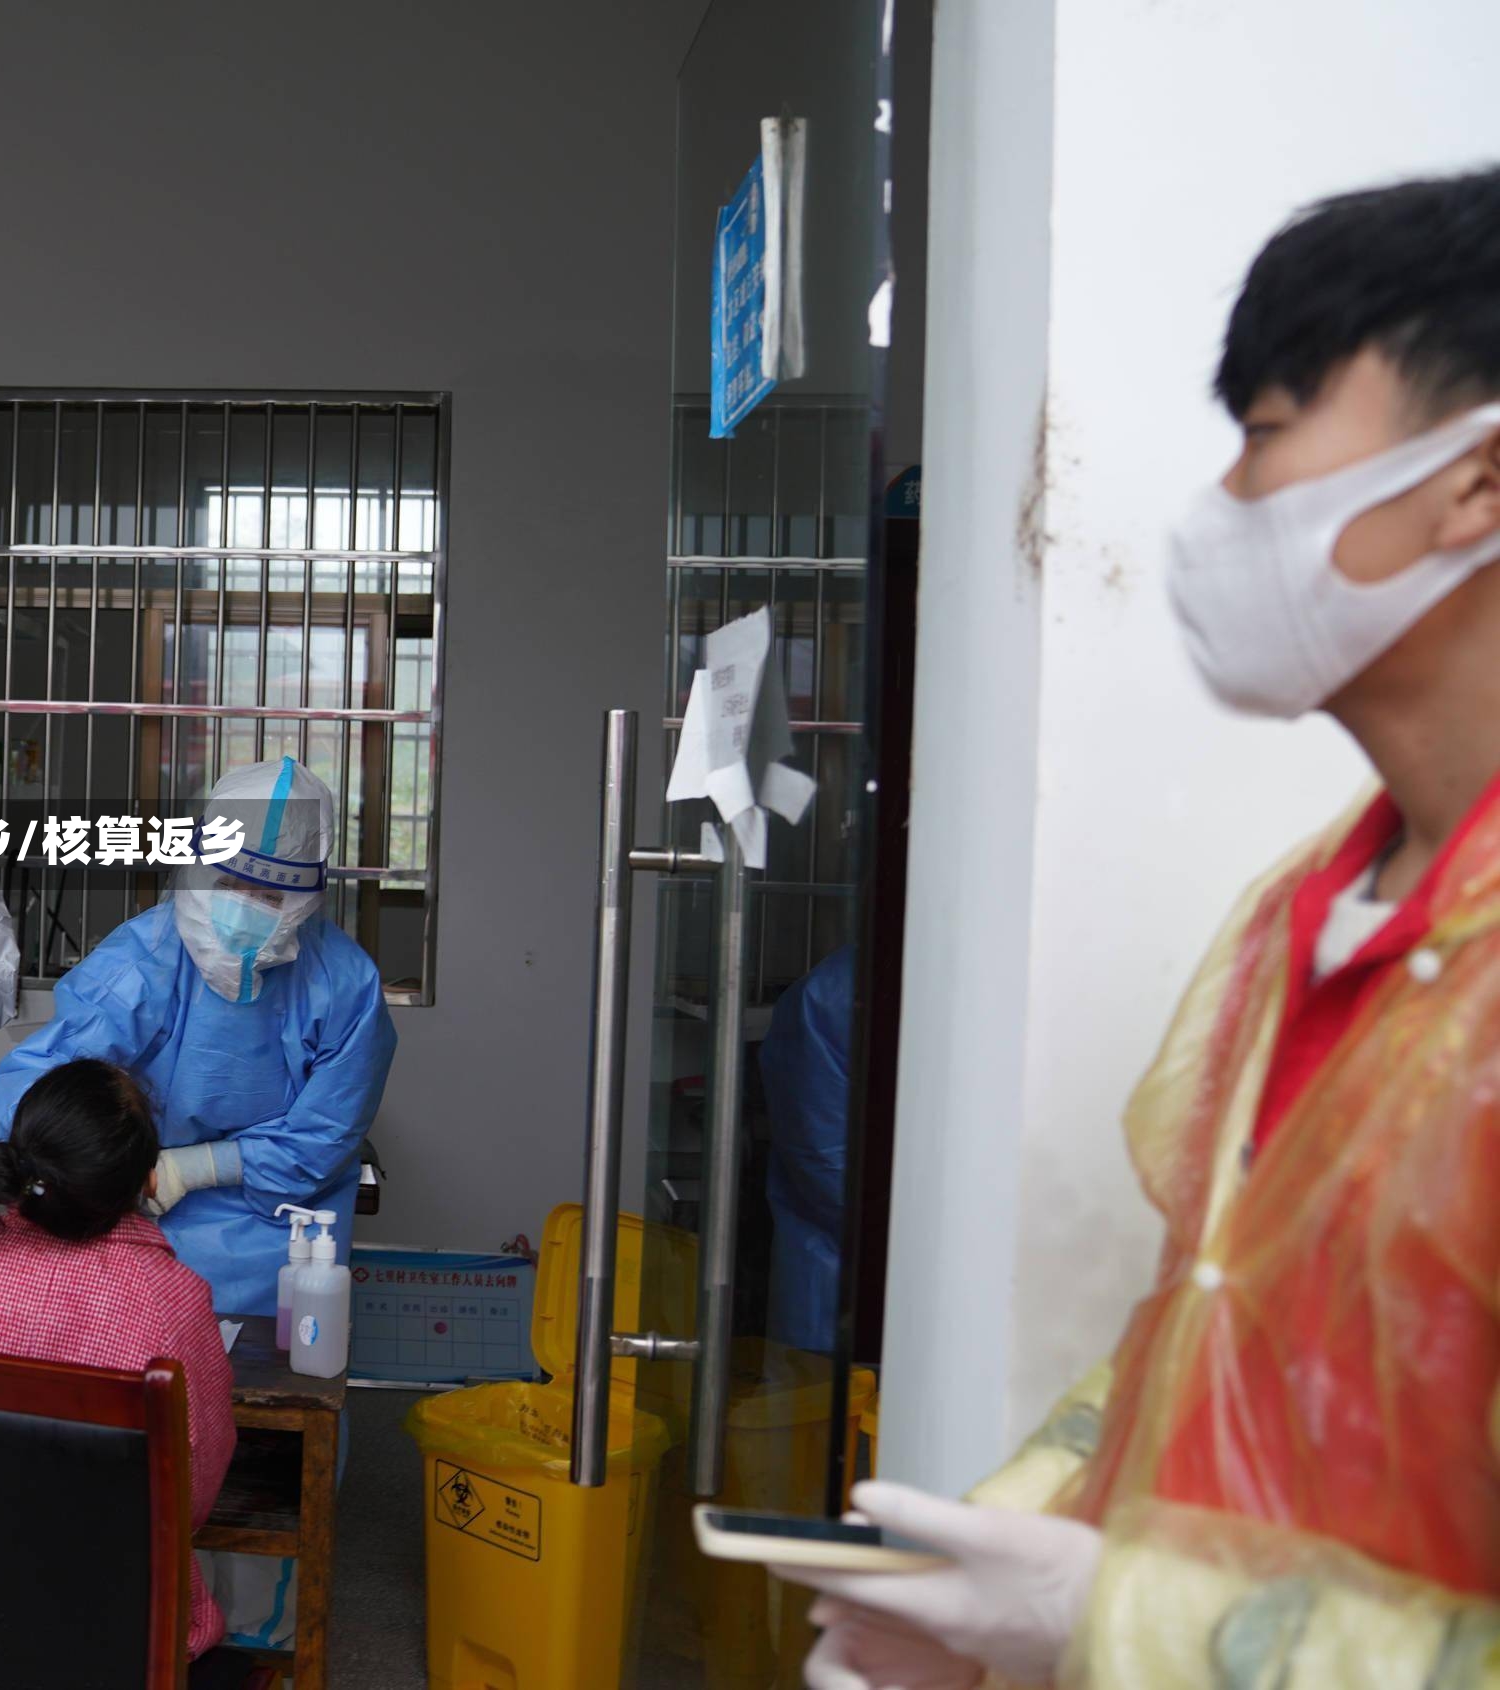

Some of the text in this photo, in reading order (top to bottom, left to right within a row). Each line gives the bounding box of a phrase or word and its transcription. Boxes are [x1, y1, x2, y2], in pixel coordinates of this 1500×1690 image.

[227, 857, 301, 884] 用隔离面罩
